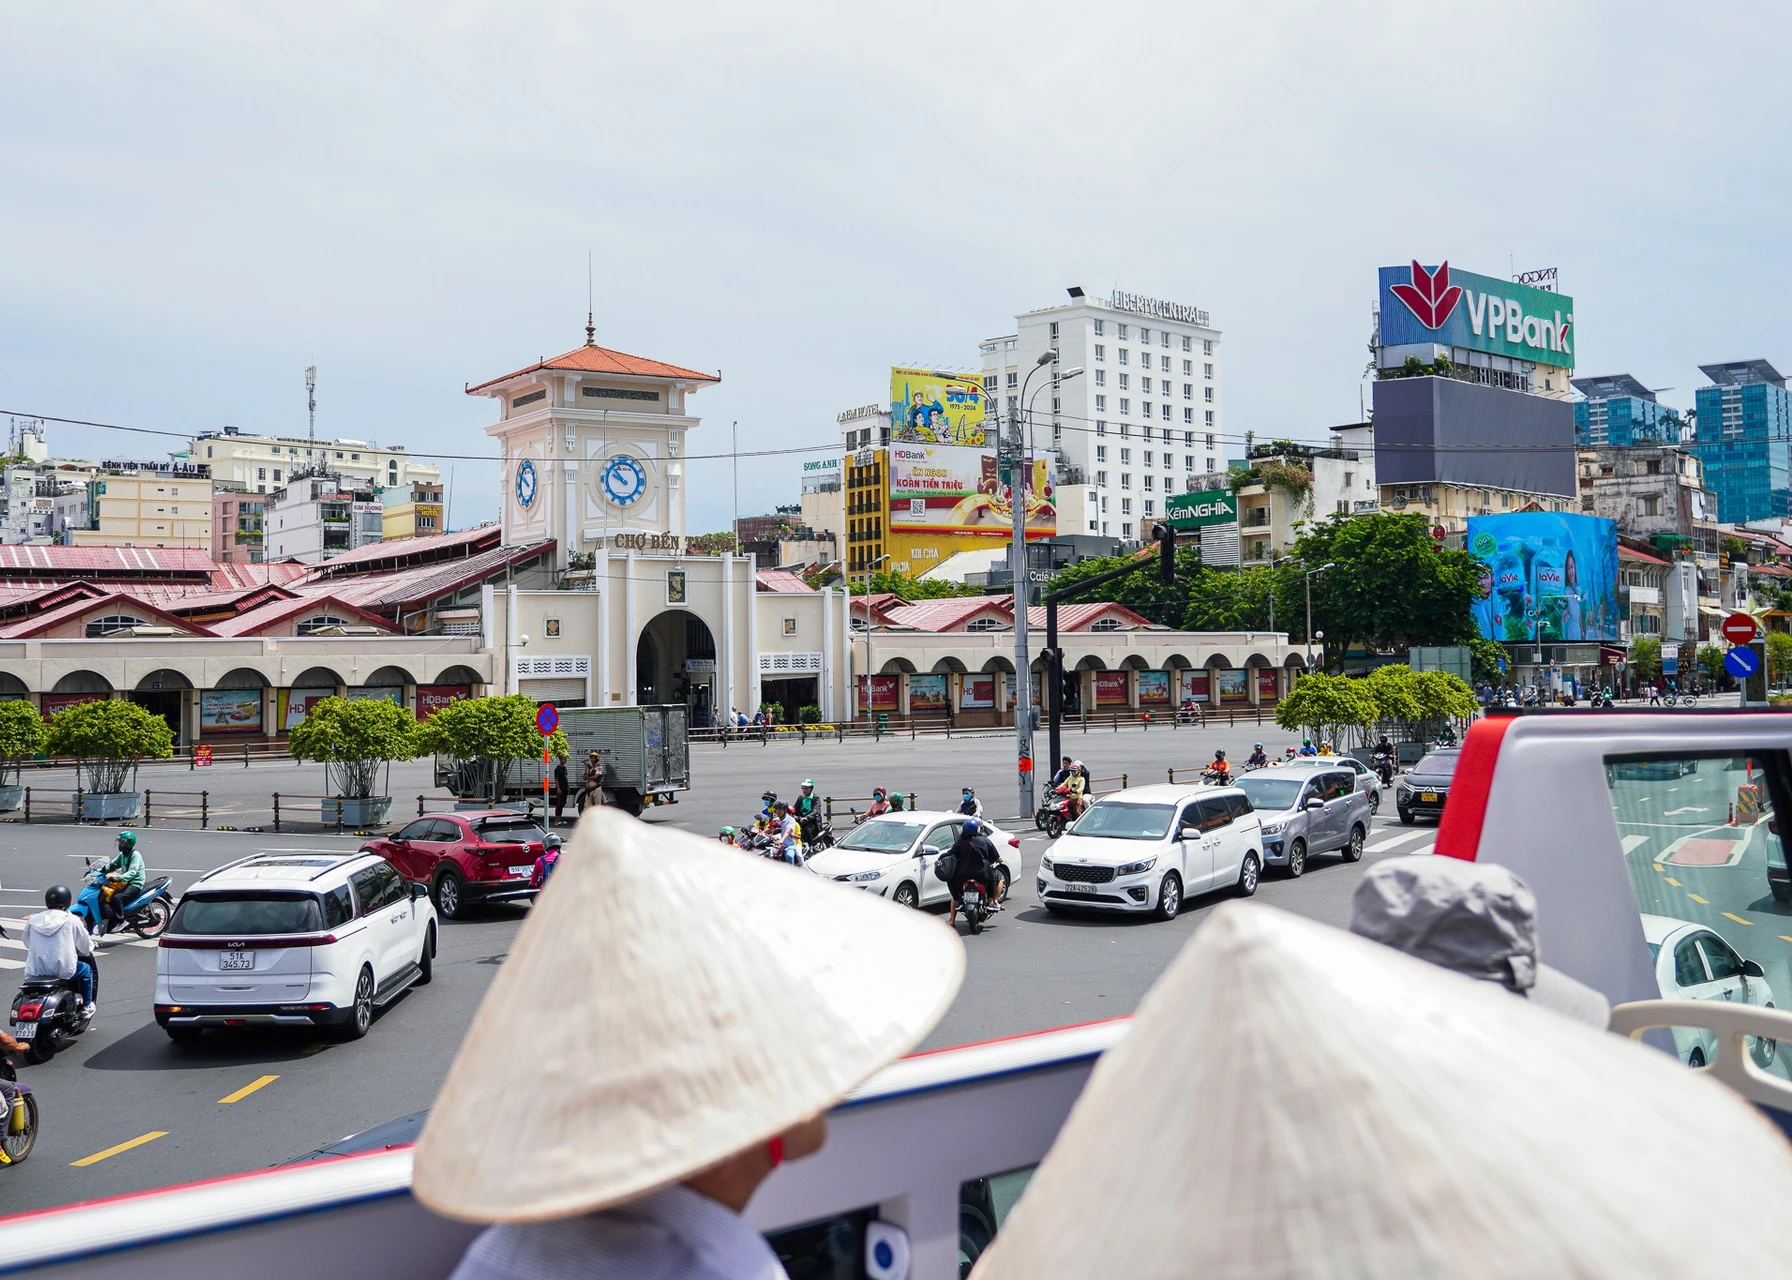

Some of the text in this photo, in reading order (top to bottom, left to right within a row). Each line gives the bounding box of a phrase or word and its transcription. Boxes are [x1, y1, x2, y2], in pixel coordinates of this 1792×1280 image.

[1112, 290, 1154, 315] LIBERTY
[1155, 300, 1201, 325] CENTRAL
[1465, 289, 1573, 354] VPBank
[894, 450, 925, 459] HDBank
[804, 459, 837, 471] SONG ANH
[924, 468, 947, 478] NGON
[941, 480, 963, 491] TRIỆU
[614, 532, 646, 550] CHỢ
[650, 530, 680, 550] BẾN
[923, 548, 939, 559] CHA
[1029, 570, 1049, 582] Café
[963, 687, 974, 696] HD
[289, 703, 305, 714] HD
[230, 952, 244, 960] 51K
[223, 960, 250, 968] 345.73
